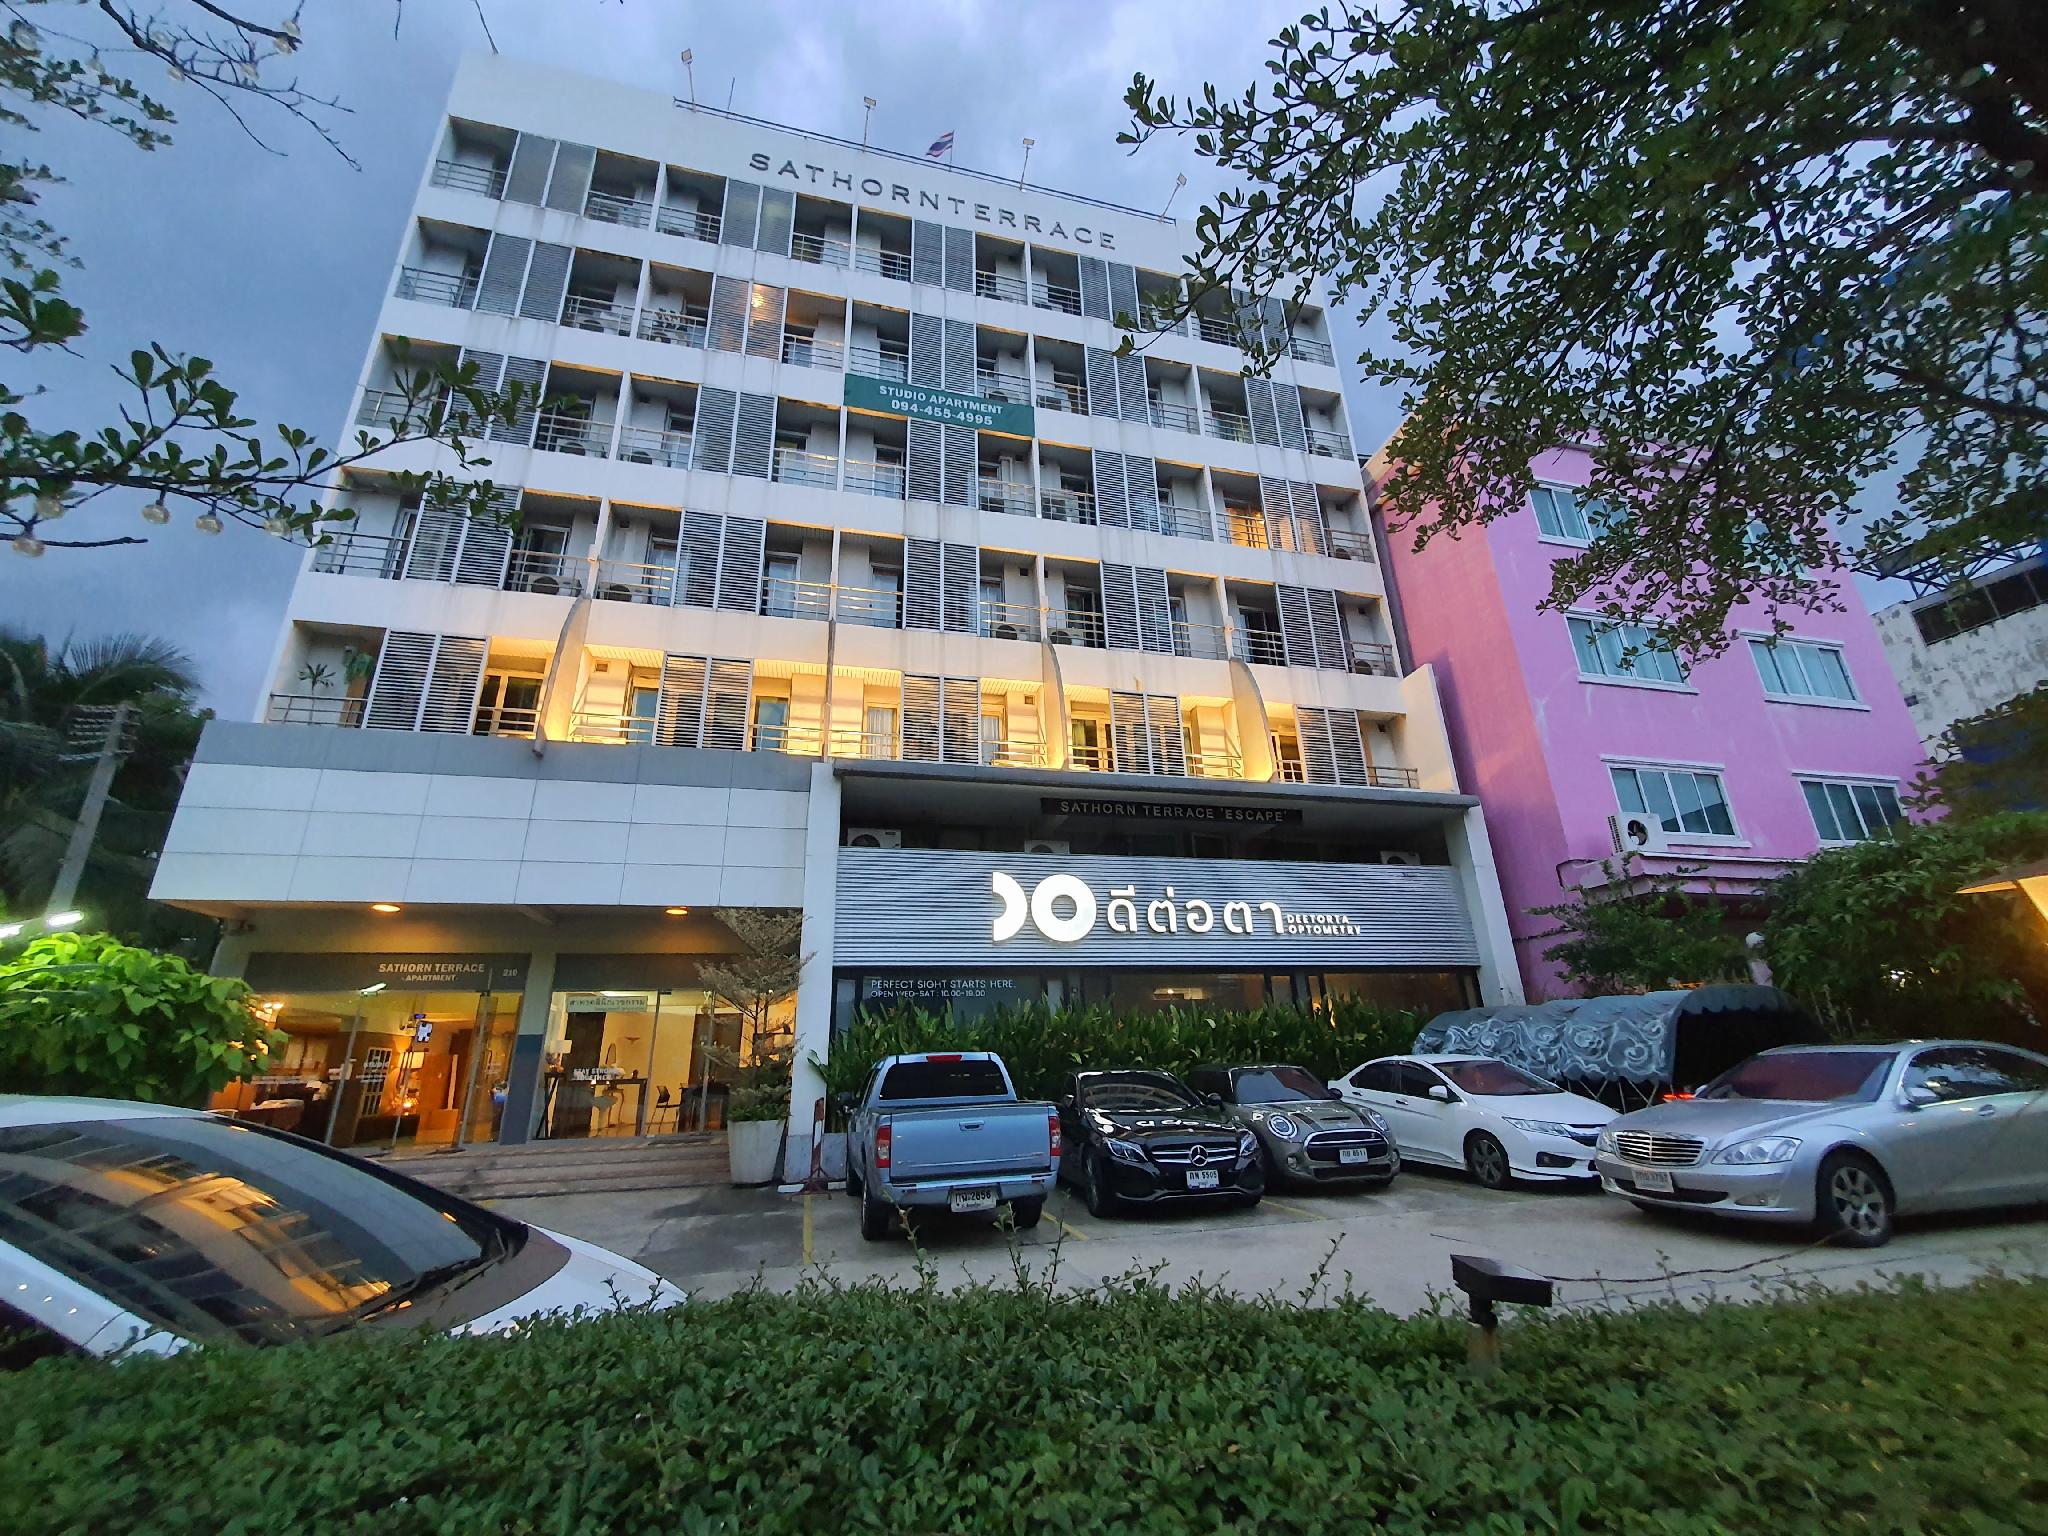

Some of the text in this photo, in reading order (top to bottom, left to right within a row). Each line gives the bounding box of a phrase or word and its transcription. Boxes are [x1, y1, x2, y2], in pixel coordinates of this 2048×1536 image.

[879, 385, 1004, 414] STUDIO APARTMENT
[891, 399, 993, 426] 094-455-4995
[1060, 801, 1136, 816] SATHORN
[1143, 805, 1215, 819] TERRACE
[1107, 884, 1284, 935] ดีต่อตา
[1287, 914, 1350, 924] DEETORTA
[1288, 925, 1361, 935] OPTOMETRY
[379, 963, 485, 973] SATHORN TERRACE
[871, 979, 914, 989] PERFECT
[917, 979, 947, 989] SIGHT
[950, 979, 986, 989] STARTS
[871, 990, 894, 998] OPEN
